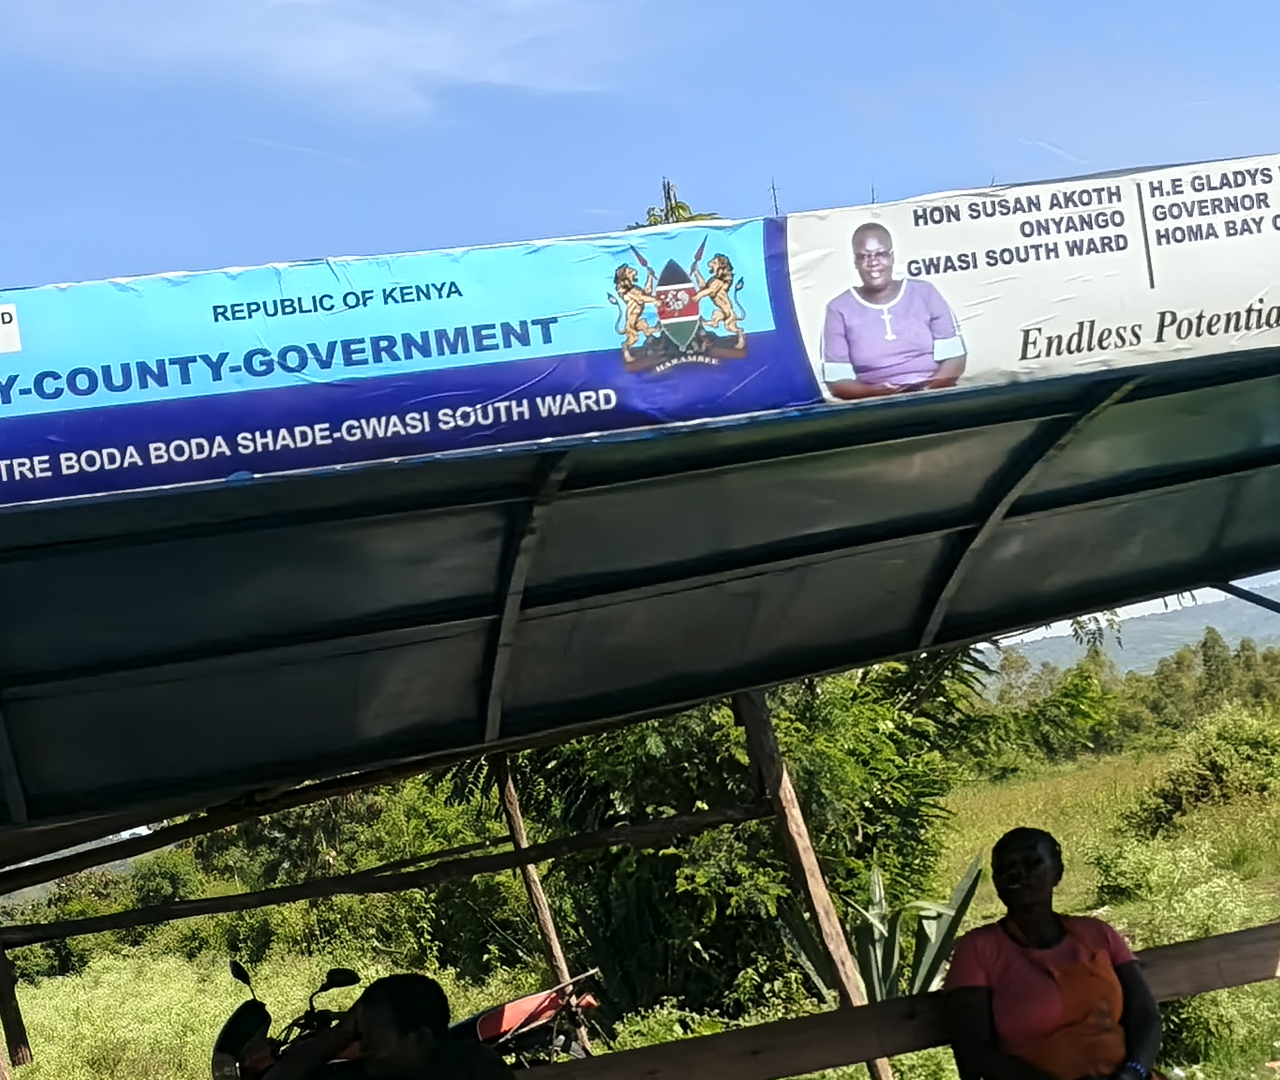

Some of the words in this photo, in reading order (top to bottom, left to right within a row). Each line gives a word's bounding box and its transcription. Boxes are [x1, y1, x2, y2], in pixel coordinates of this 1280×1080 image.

[1149, 179, 1184, 199] H.E
[1189, 168, 1273, 194] GLADYS
[913, 205, 961, 227] HON
[968, 196, 1041, 221] SUSAN
[1049, 186, 1122, 212] AKOTH
[1019, 211, 1125, 239] ONYANGO
[1152, 192, 1270, 221] GOVERNOR
[1155, 223, 1219, 246] HOMA
[1224, 215, 1265, 238] BAY
[906, 251, 978, 277] GWASI
[984, 242, 1060, 268] SOUTH
[1065, 234, 1128, 260] WARD
[212, 293, 335, 323] REPUBLIC
[342, 290, 375, 309] OF
[382, 281, 463, 306] KENYA
[1019, 317, 1142, 361] Endless
[60, 445, 143, 475] BODA
[148, 435, 236, 465] BODA
[236, 413, 430, 454] SHADE-GWASI
[438, 399, 530, 430] SOUTH
[536, 388, 617, 418] WARD
